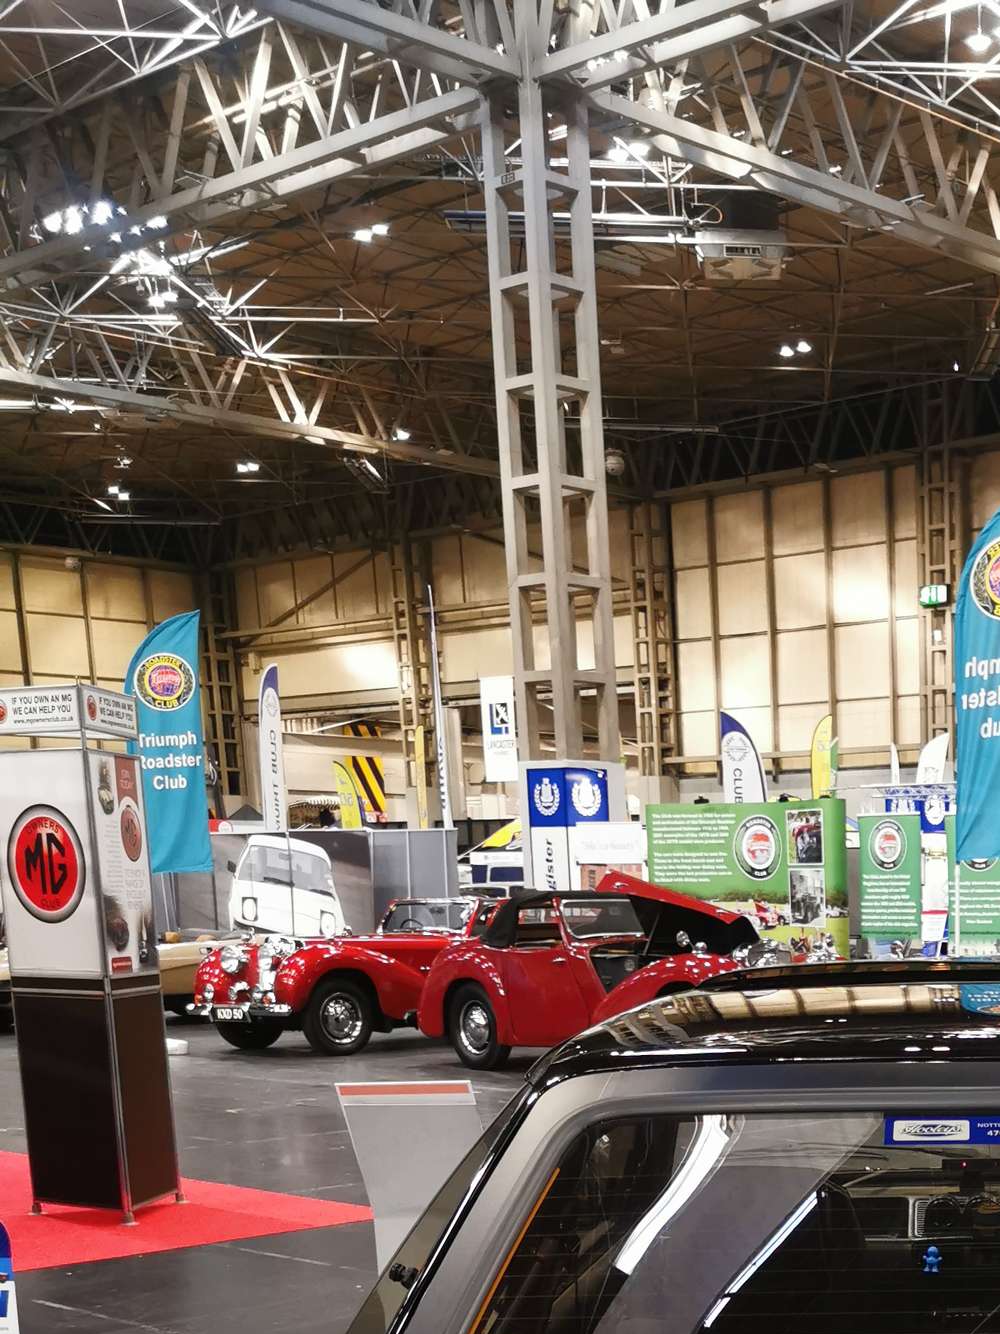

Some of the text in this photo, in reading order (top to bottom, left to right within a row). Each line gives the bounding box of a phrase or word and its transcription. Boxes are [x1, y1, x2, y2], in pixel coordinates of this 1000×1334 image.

[19, 696, 32, 704] YOU
[33, 695, 49, 703] OWN
[50, 694, 60, 703] AN
[61, 694, 72, 702] MG
[155, 700, 178, 708] CLUB
[12, 704, 71, 715] WE CAN HELP YOU
[139, 731, 197, 749] Triumph
[153, 774, 187, 790] Club
[24, 832, 68, 896] MG
[233, 1009, 243, 1019] 50
